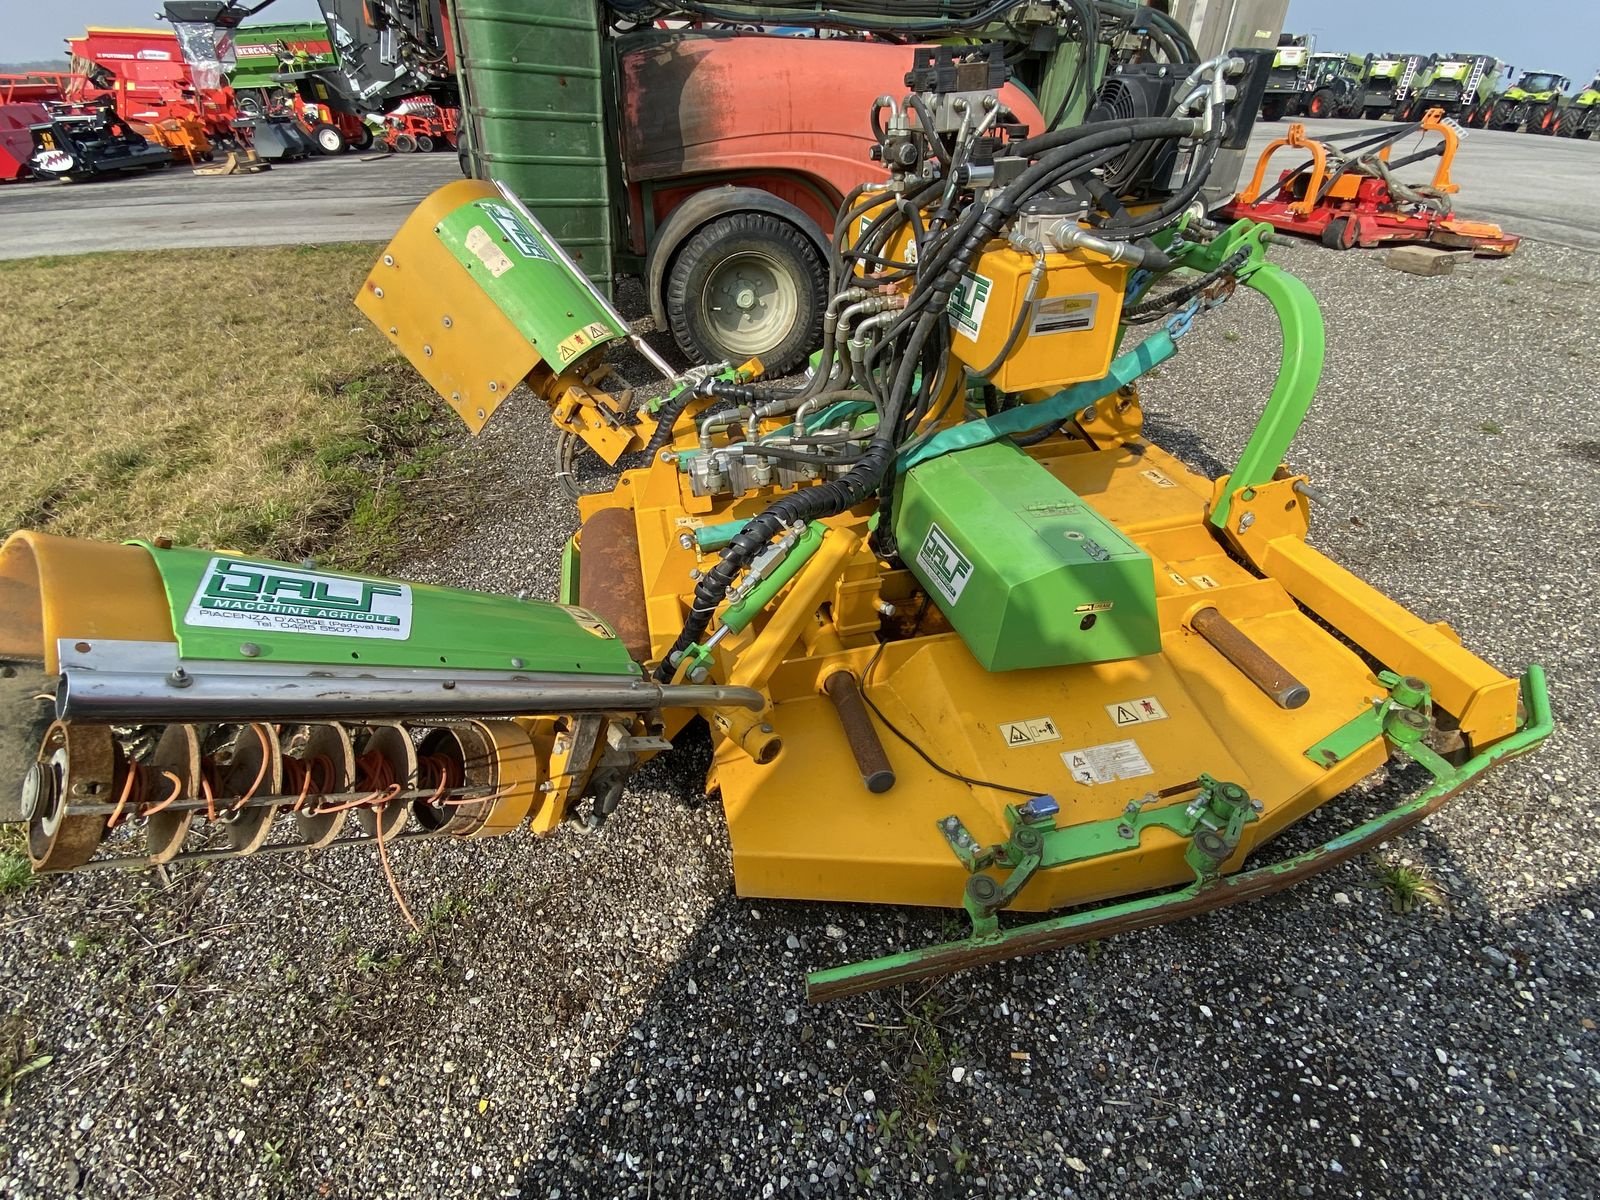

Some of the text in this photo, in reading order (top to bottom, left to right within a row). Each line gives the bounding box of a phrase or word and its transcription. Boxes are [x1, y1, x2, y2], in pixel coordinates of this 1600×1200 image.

[199, 609, 400, 633] PIACENZA D'ADIGE (Padova) Italia
[213, 600, 393, 623] MACCHINE AGRICOLE
[255, 620, 359, 634] Tel. 0425 55071
